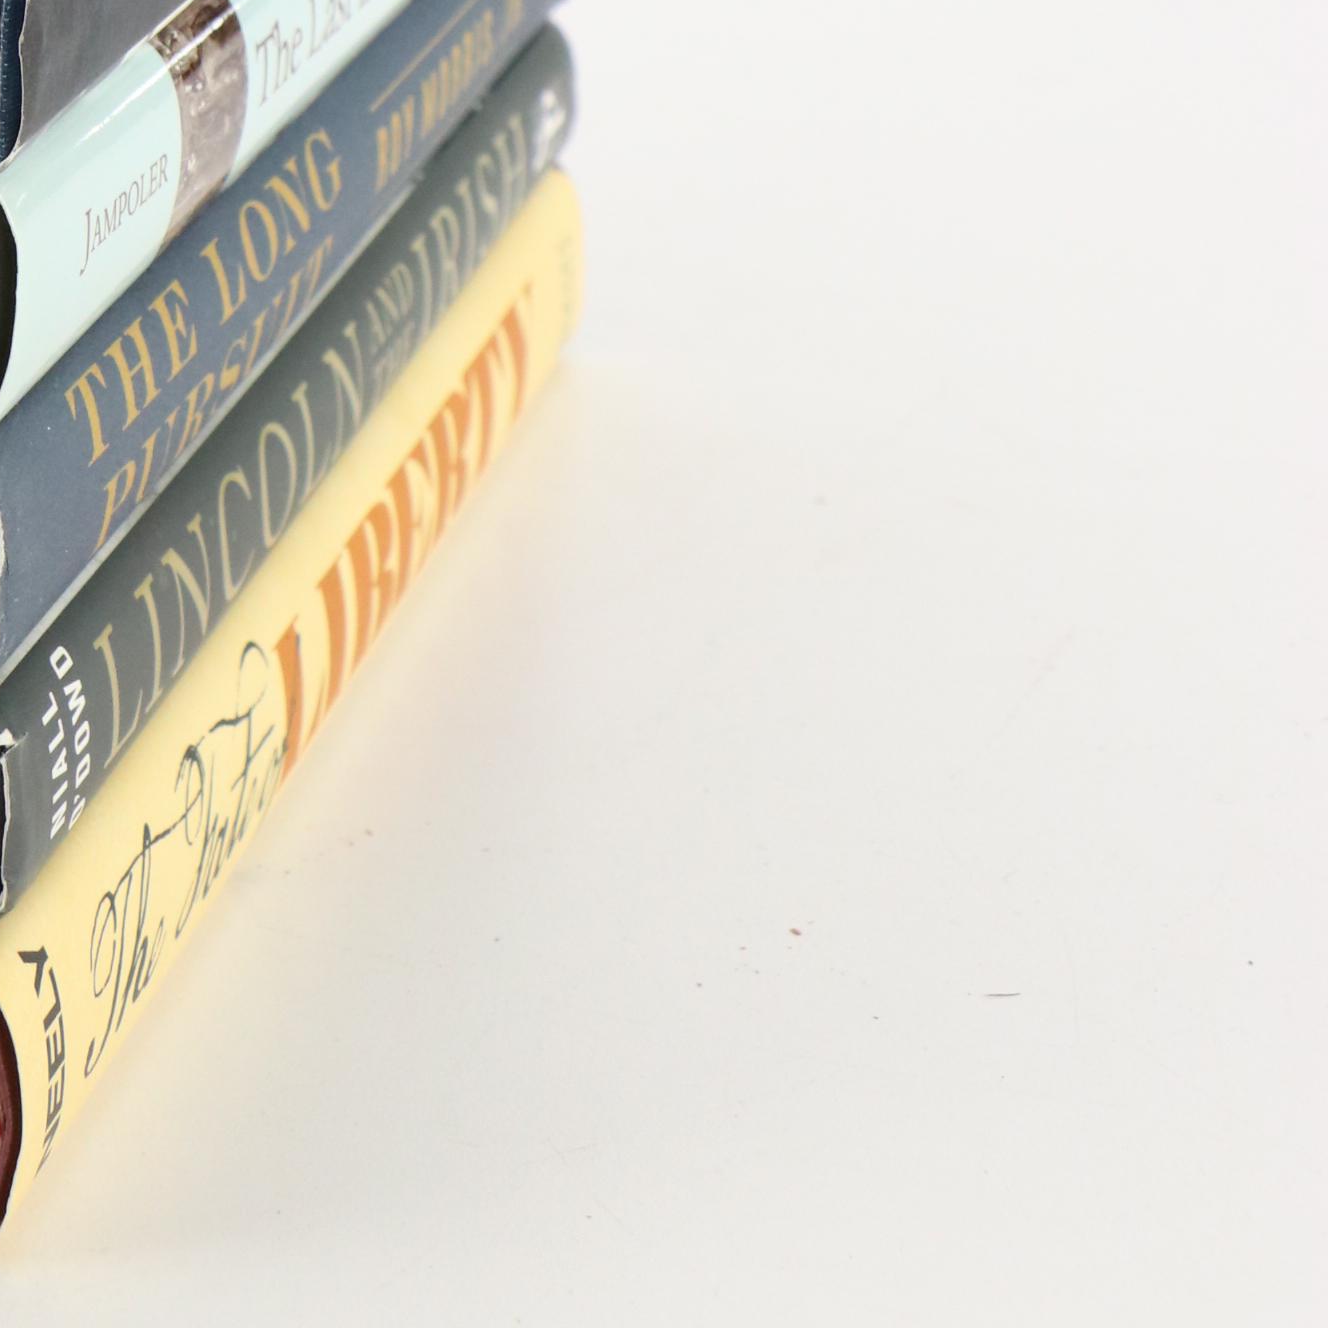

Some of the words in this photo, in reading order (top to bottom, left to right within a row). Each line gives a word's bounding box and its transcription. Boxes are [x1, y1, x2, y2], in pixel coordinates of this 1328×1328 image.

[255, 20, 305, 108] The
[64, 279, 198, 468] THE
[199, 127, 343, 326] LONG
[410, 112, 529, 342] IRISH
[92, 321, 365, 771] LINCOLN
[274, 280, 535, 790] LIBERTY
[41, 691, 68, 840] NIALL
[49, 645, 92, 830] O'DOWD
[17, 945, 66, 1178] NEELY
[83, 821, 166, 1078] The
